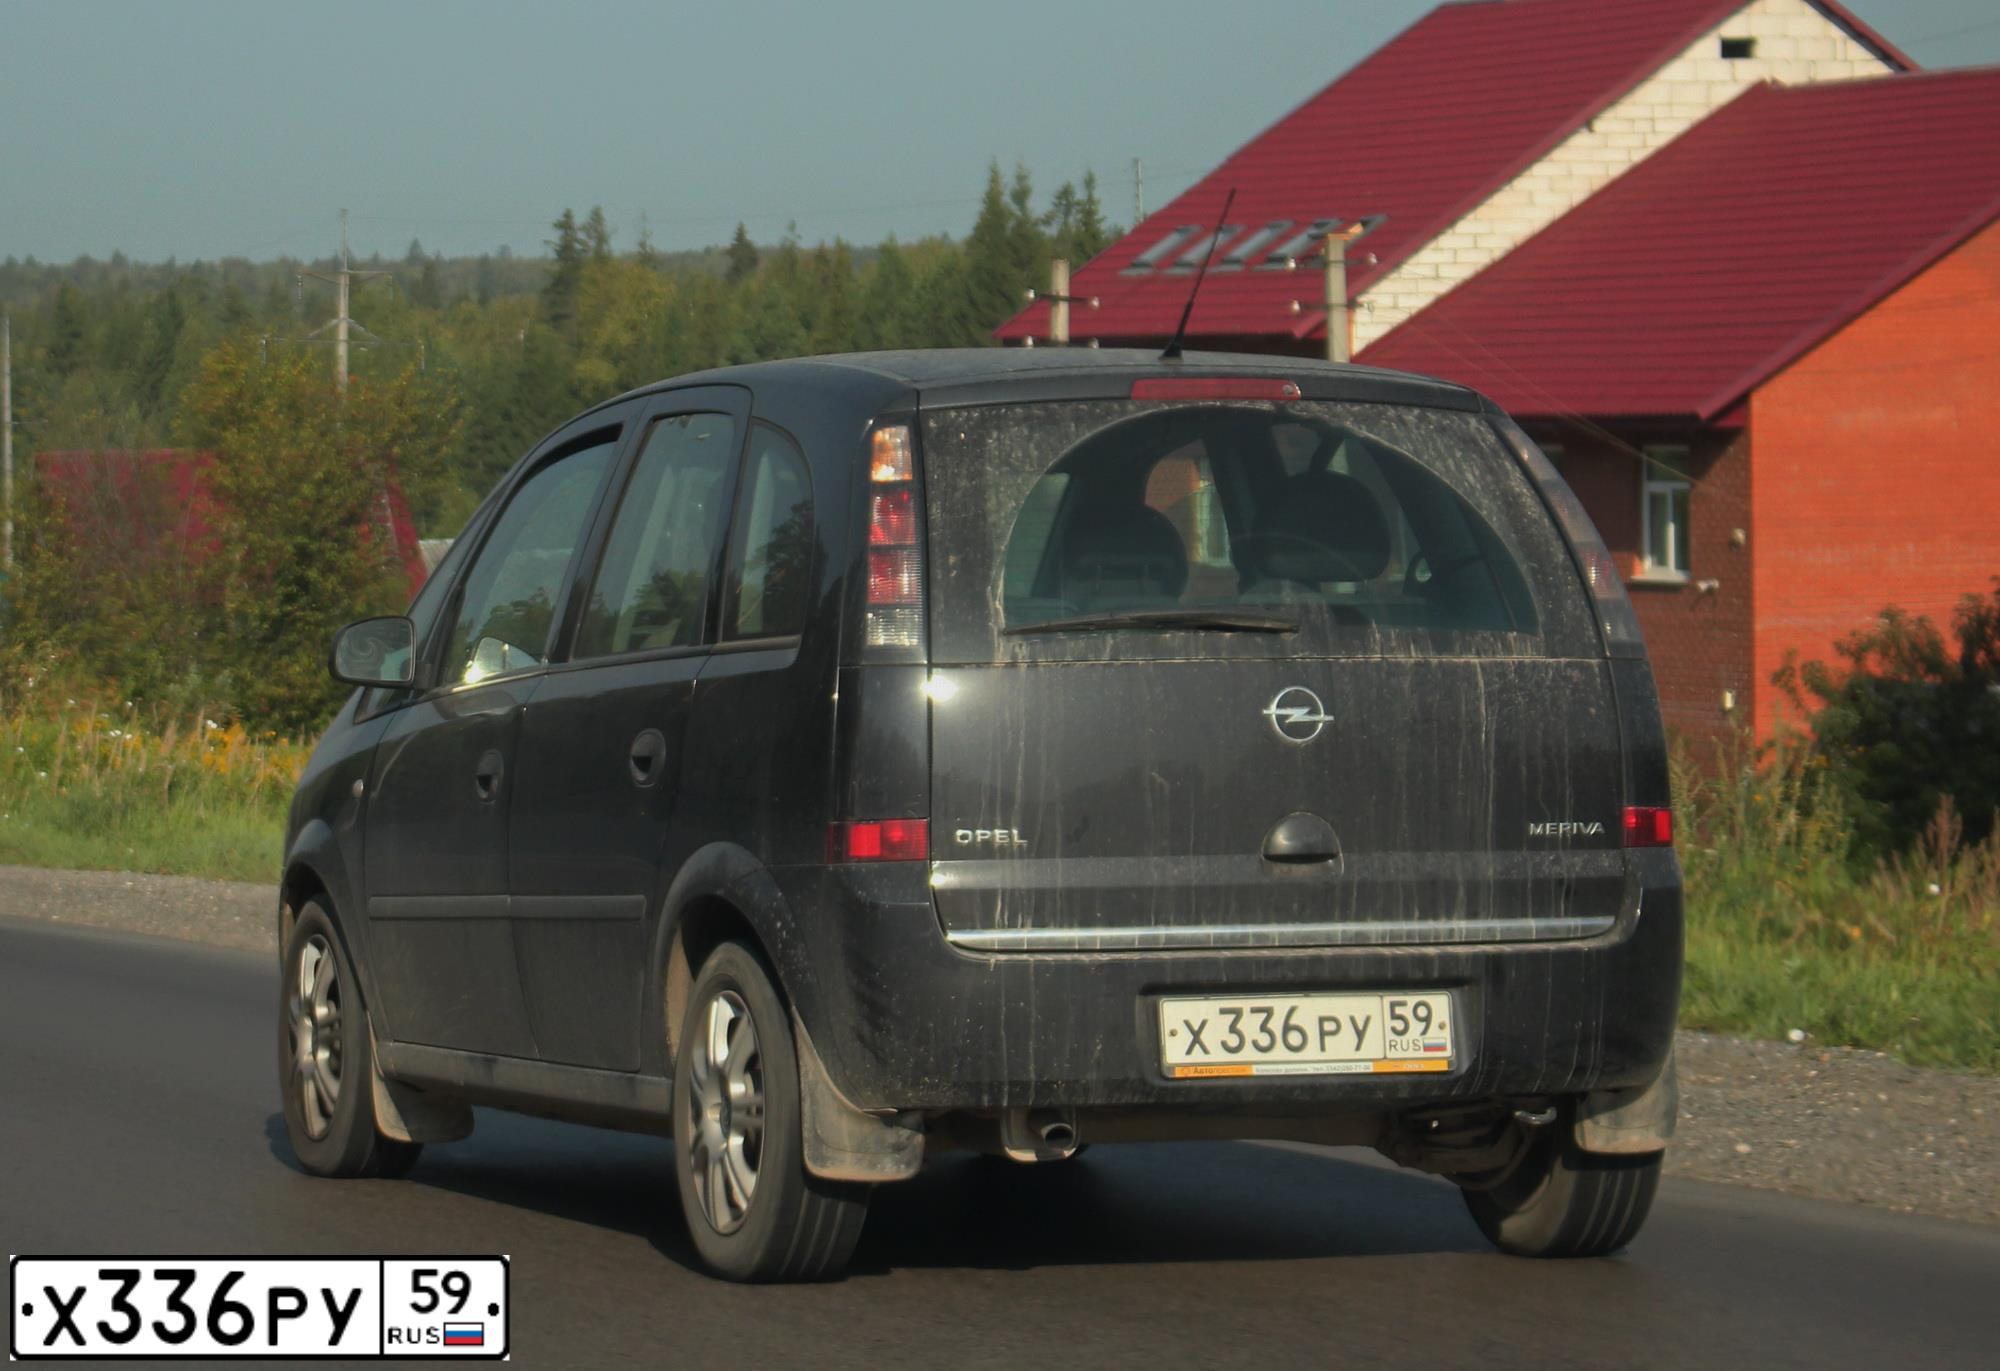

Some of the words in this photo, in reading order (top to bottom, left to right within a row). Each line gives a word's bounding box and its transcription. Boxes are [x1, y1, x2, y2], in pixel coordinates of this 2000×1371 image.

[955, 828, 1028, 844] OPEL
[1529, 822, 1605, 835] MERIVA
[1388, 1000, 1433, 1036] 59
[1389, 1038, 1422, 1053] RUS
